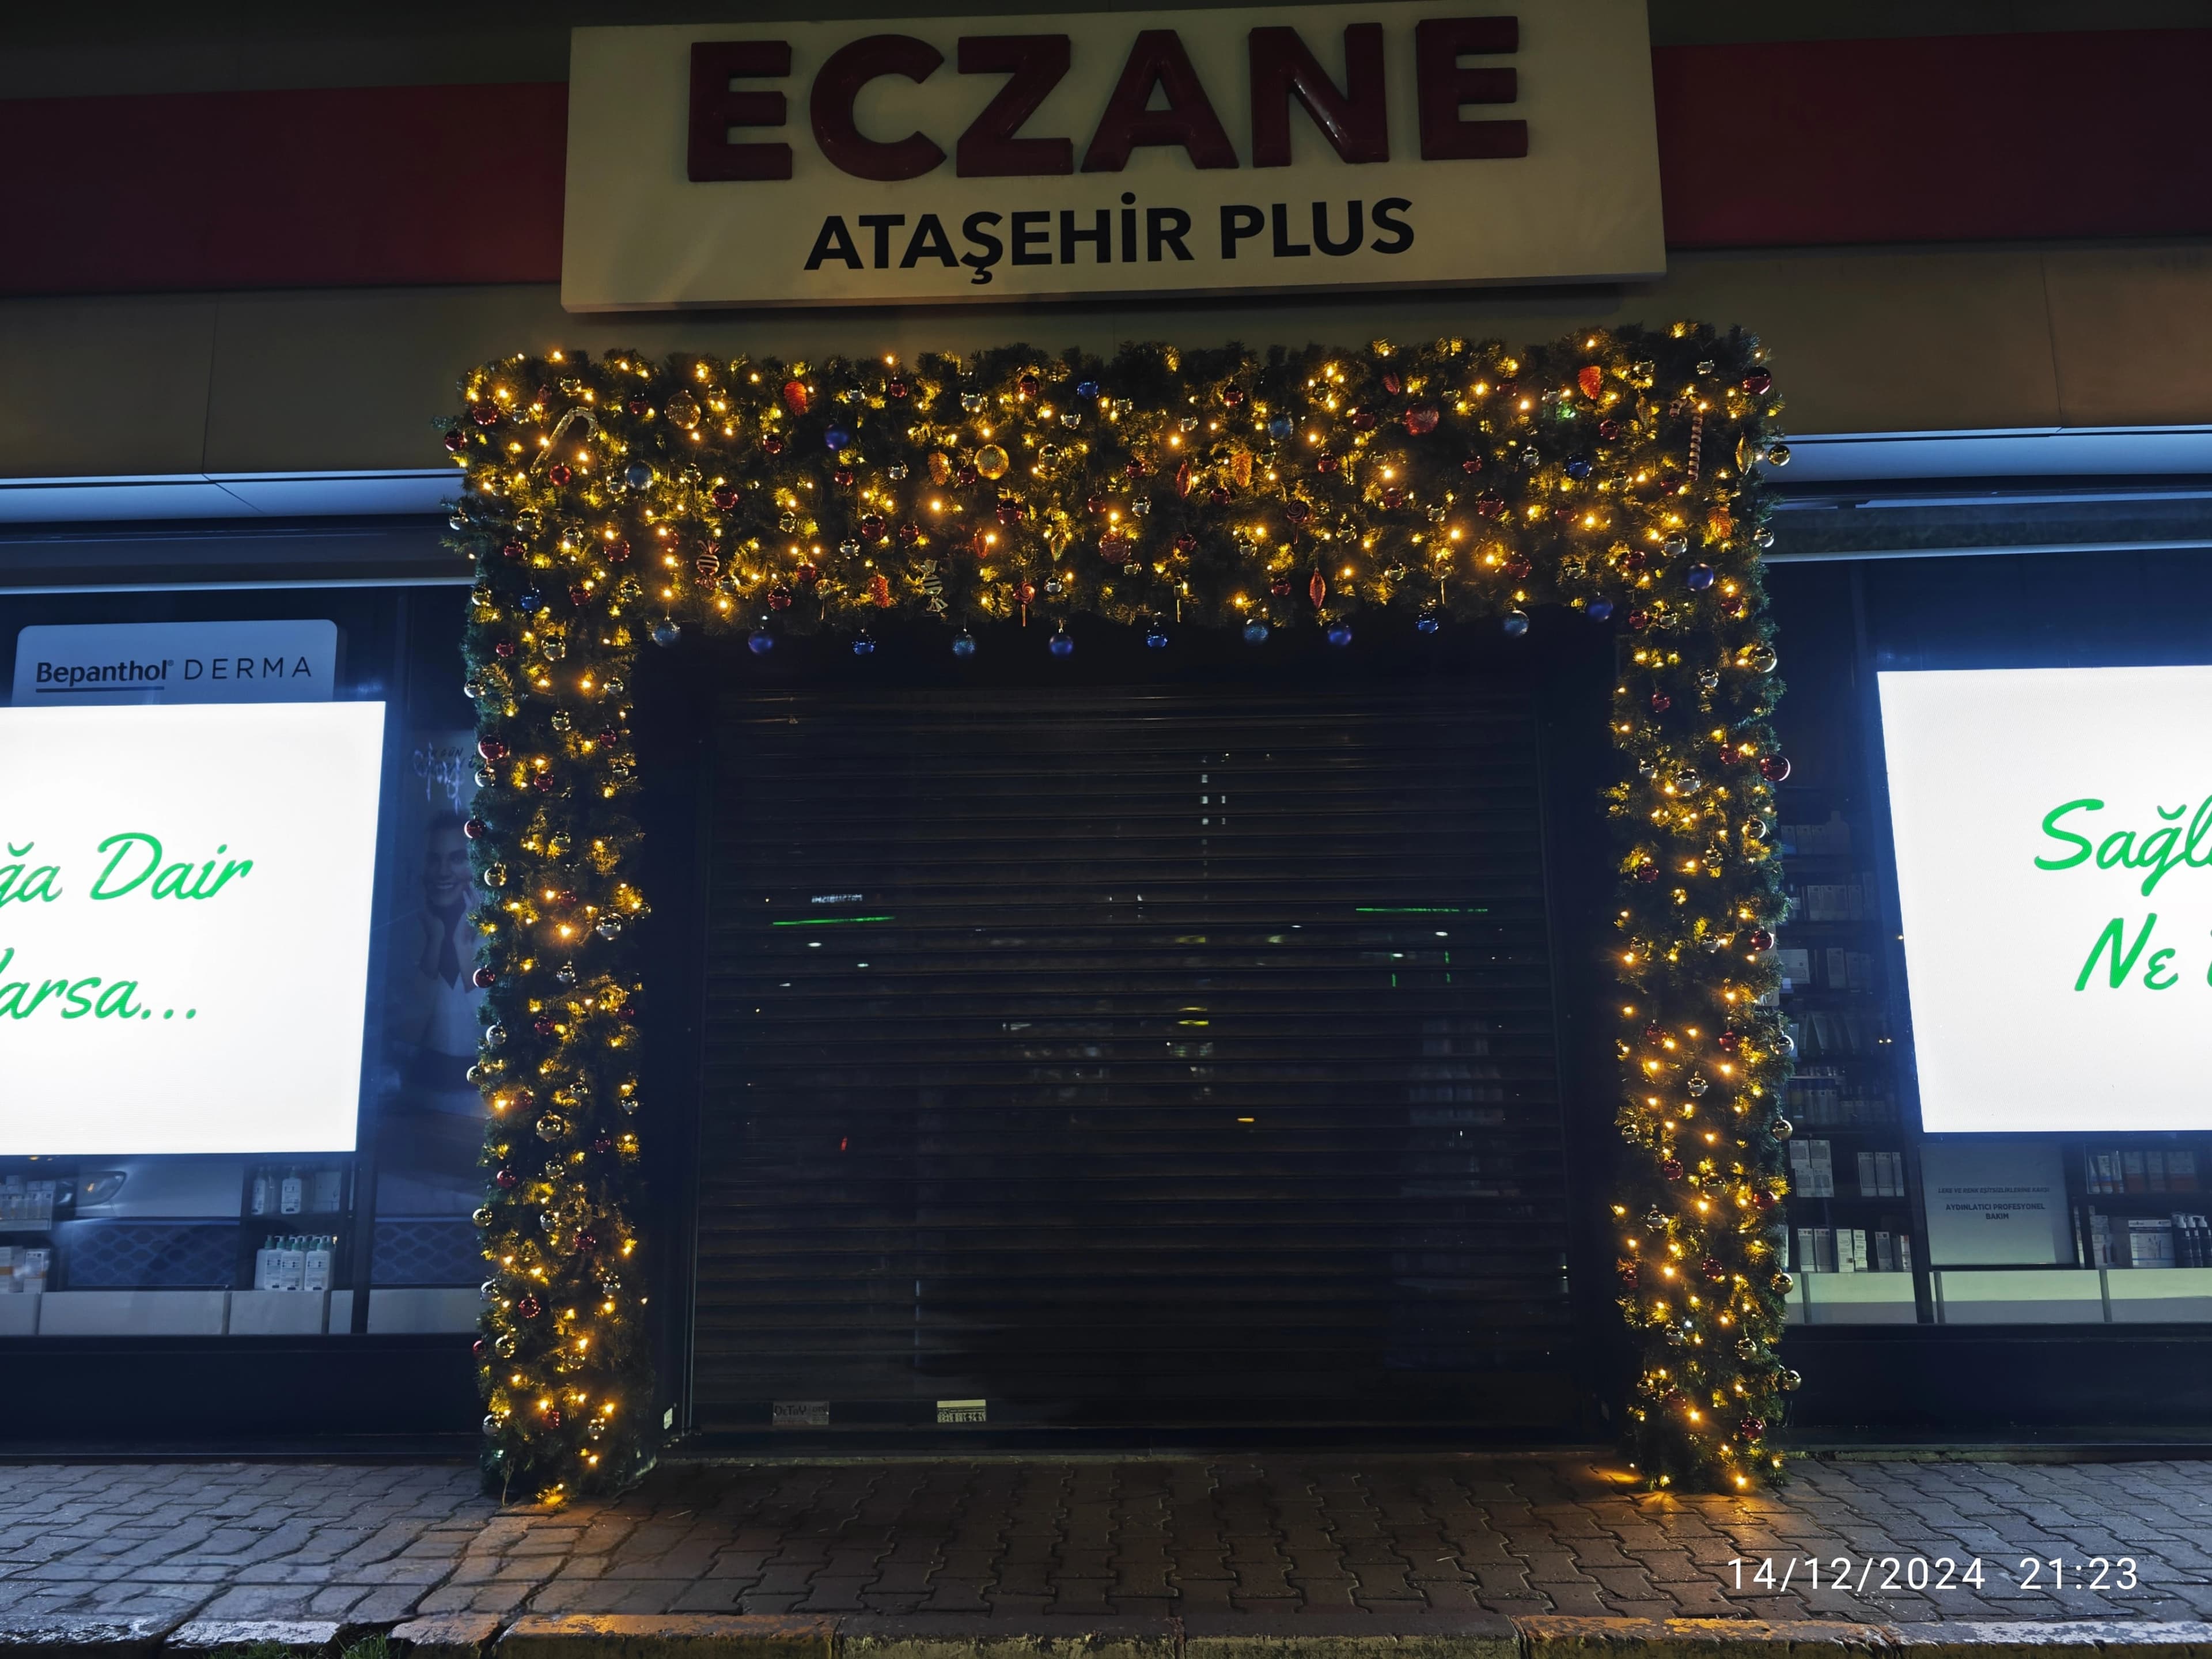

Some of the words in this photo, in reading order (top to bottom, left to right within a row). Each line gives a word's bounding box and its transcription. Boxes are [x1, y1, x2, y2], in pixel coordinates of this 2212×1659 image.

[687, 16, 1529, 183] ECZANE
[804, 192, 1195, 285] ATAŞEHİR
[1220, 197, 1414, 260] PLUS
[185, 657, 312, 680] DERMA
[90, 832, 253, 900] Dair
[2034, 794, 2212, 897] Sağl
[0, 947, 196, 1020] arsa...
[2075, 912, 2179, 991] Ne
